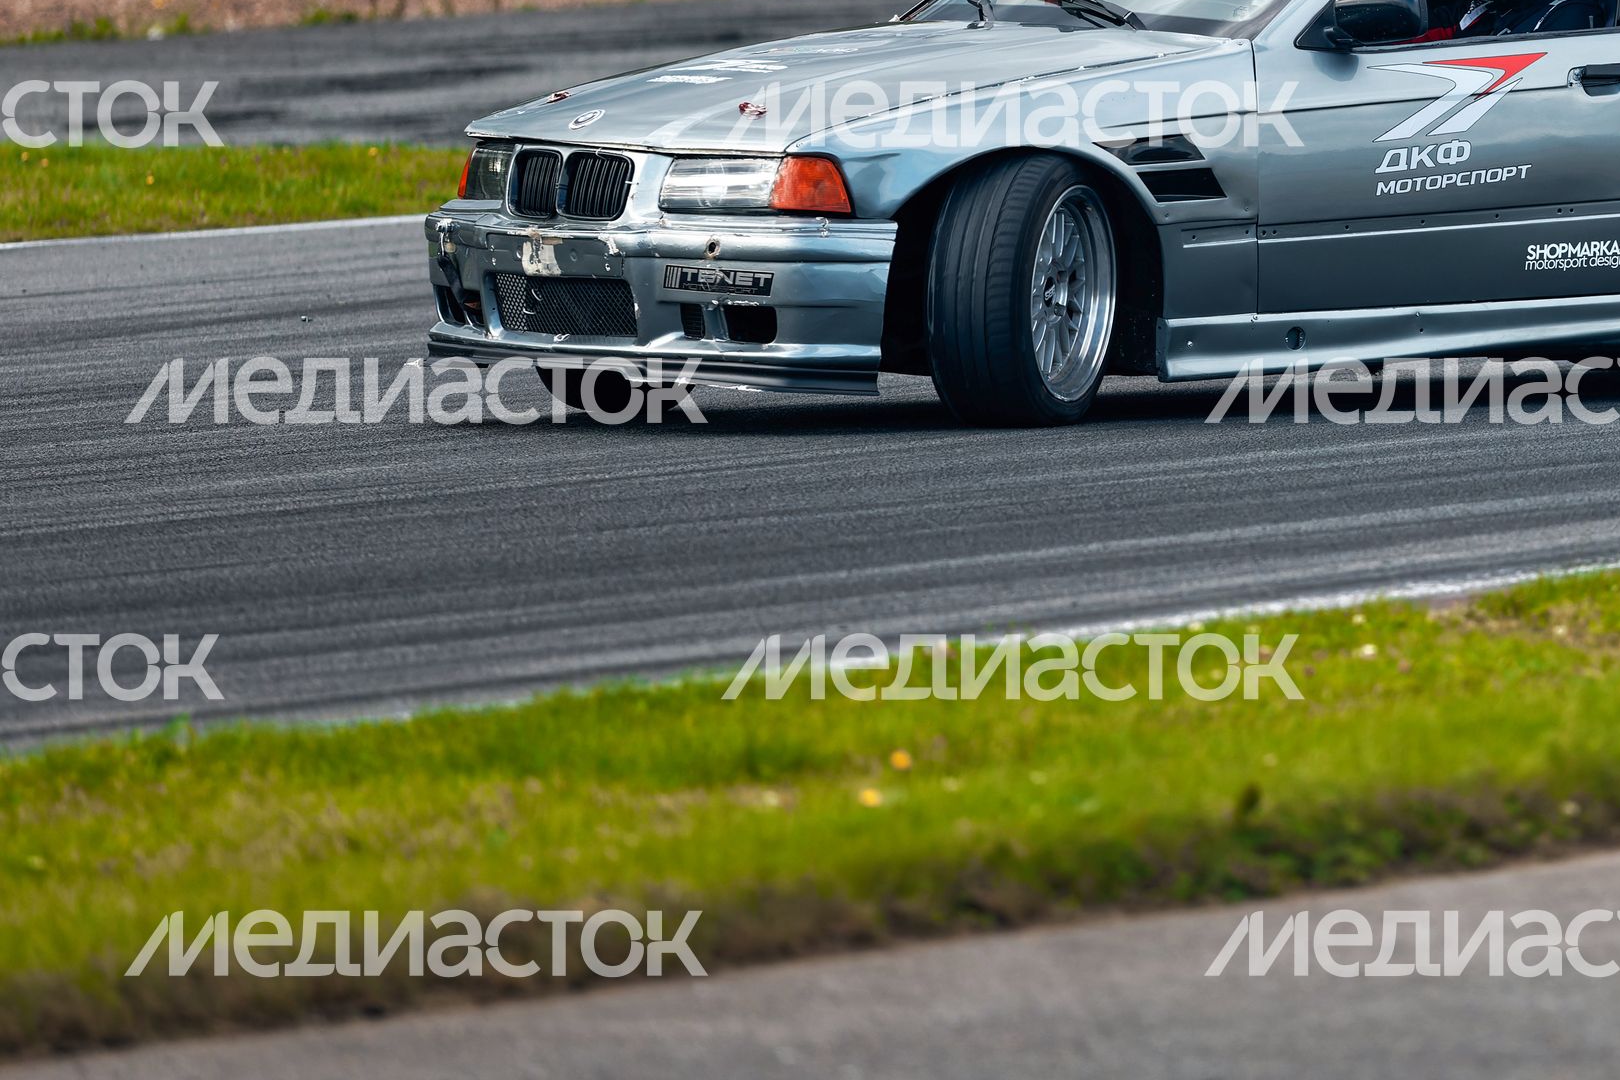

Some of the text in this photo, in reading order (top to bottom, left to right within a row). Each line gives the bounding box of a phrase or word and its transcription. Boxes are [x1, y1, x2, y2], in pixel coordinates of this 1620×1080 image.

[1375, 139, 1472, 173] ДКФ
[1375, 164, 1532, 196] МОТОРСПОРТ
[1525, 252, 1588, 271] motorsport
[1526, 240, 1620, 261] SHOPMARKA
